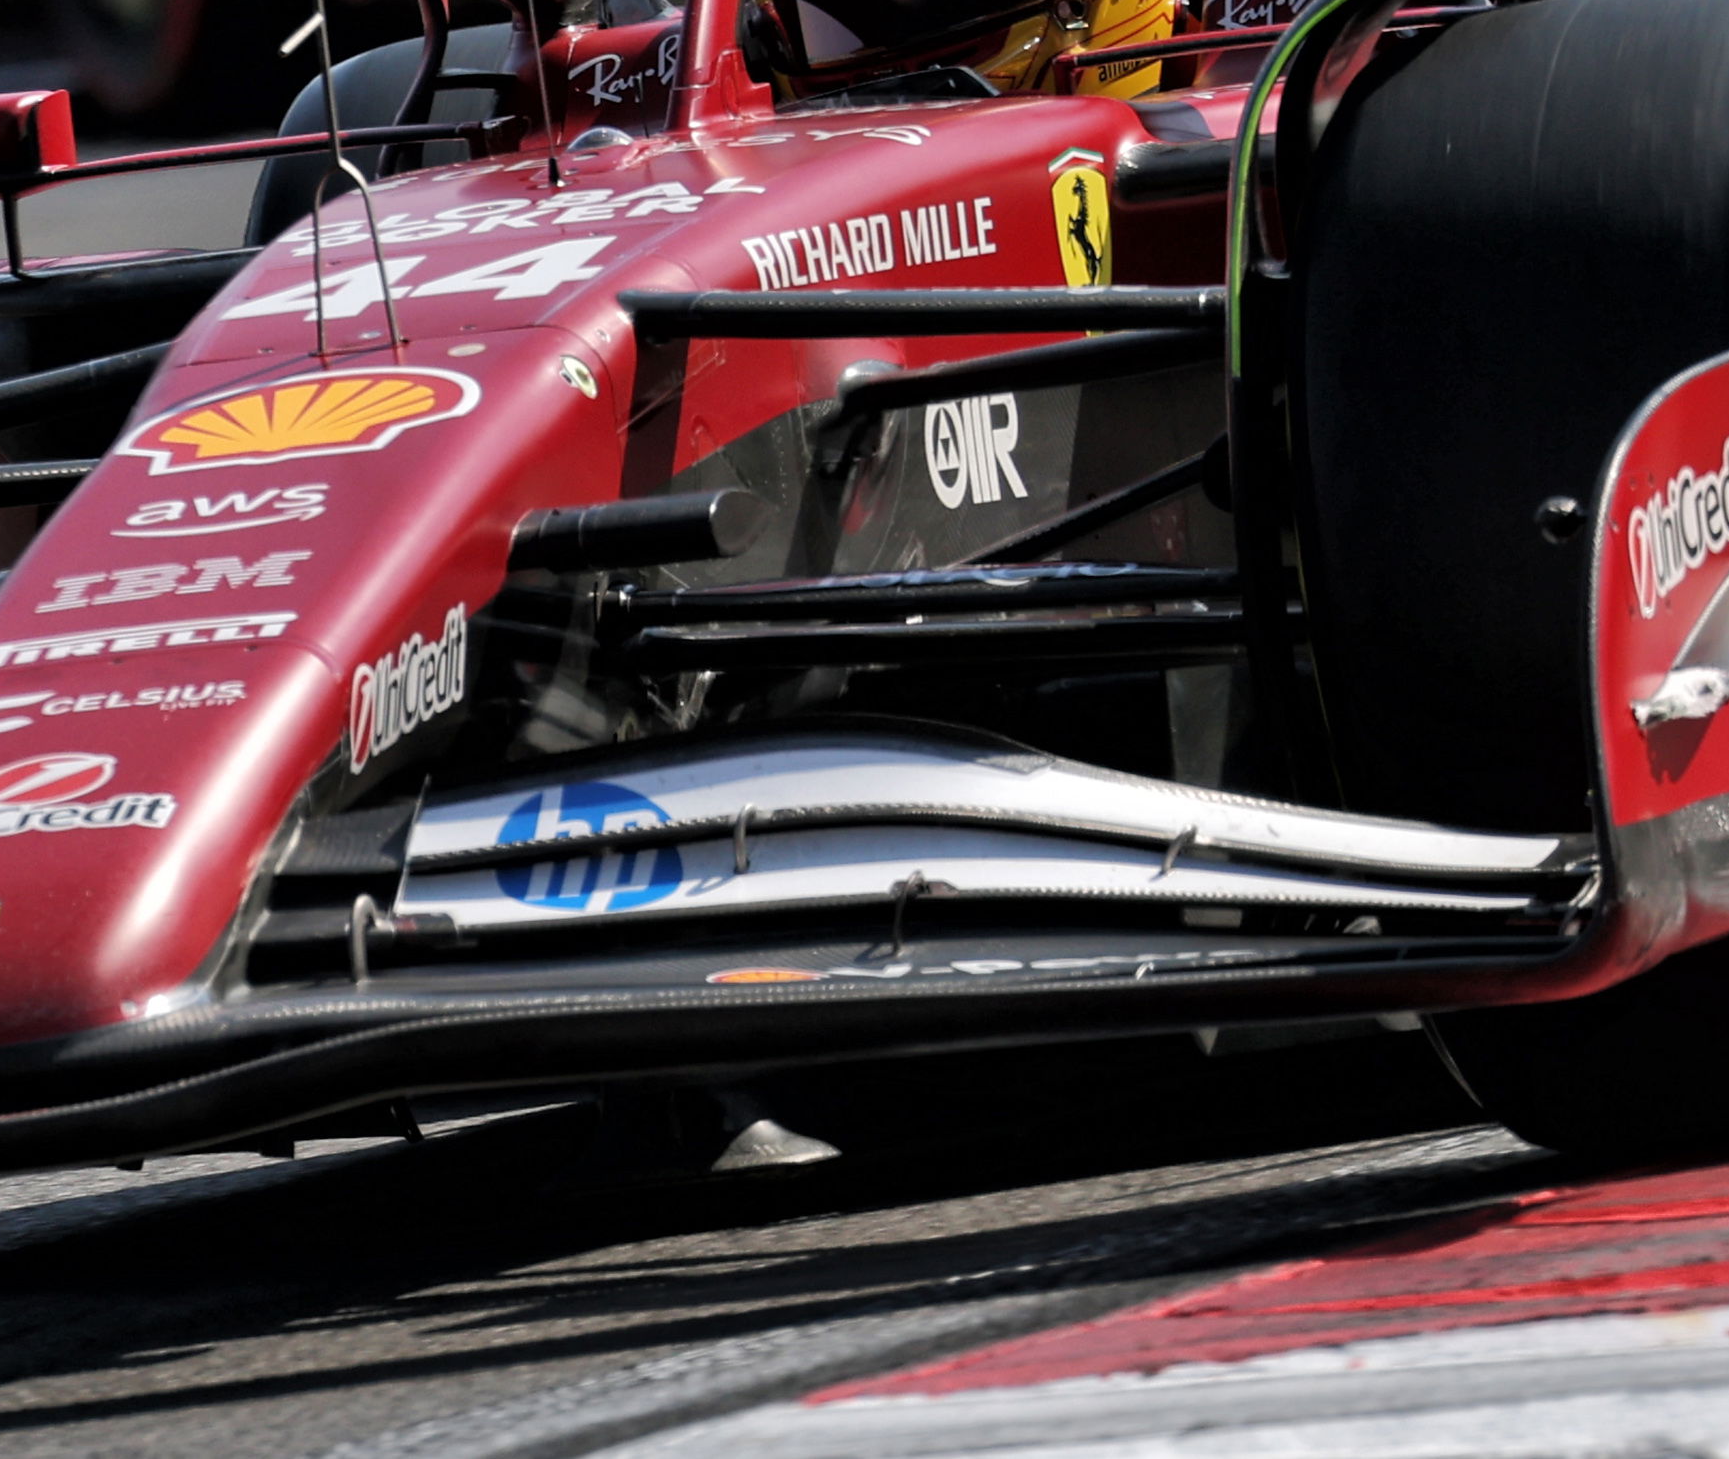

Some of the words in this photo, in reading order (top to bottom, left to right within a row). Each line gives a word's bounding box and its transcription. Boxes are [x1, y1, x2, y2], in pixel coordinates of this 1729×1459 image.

[275, 176, 766, 243] GLOBAL
[290, 194, 704, 258] POKER
[741, 213, 895, 292] RICHARD
[900, 196, 997, 267] MILLE
[220, 235, 617, 322] 44
[126, 483, 330, 527] aws
[35, 549, 314, 614] IBM
[41, 679, 247, 716] CELSIUS
[372, 604, 466, 756] UniCredit
[524, 786, 661, 913] hp
